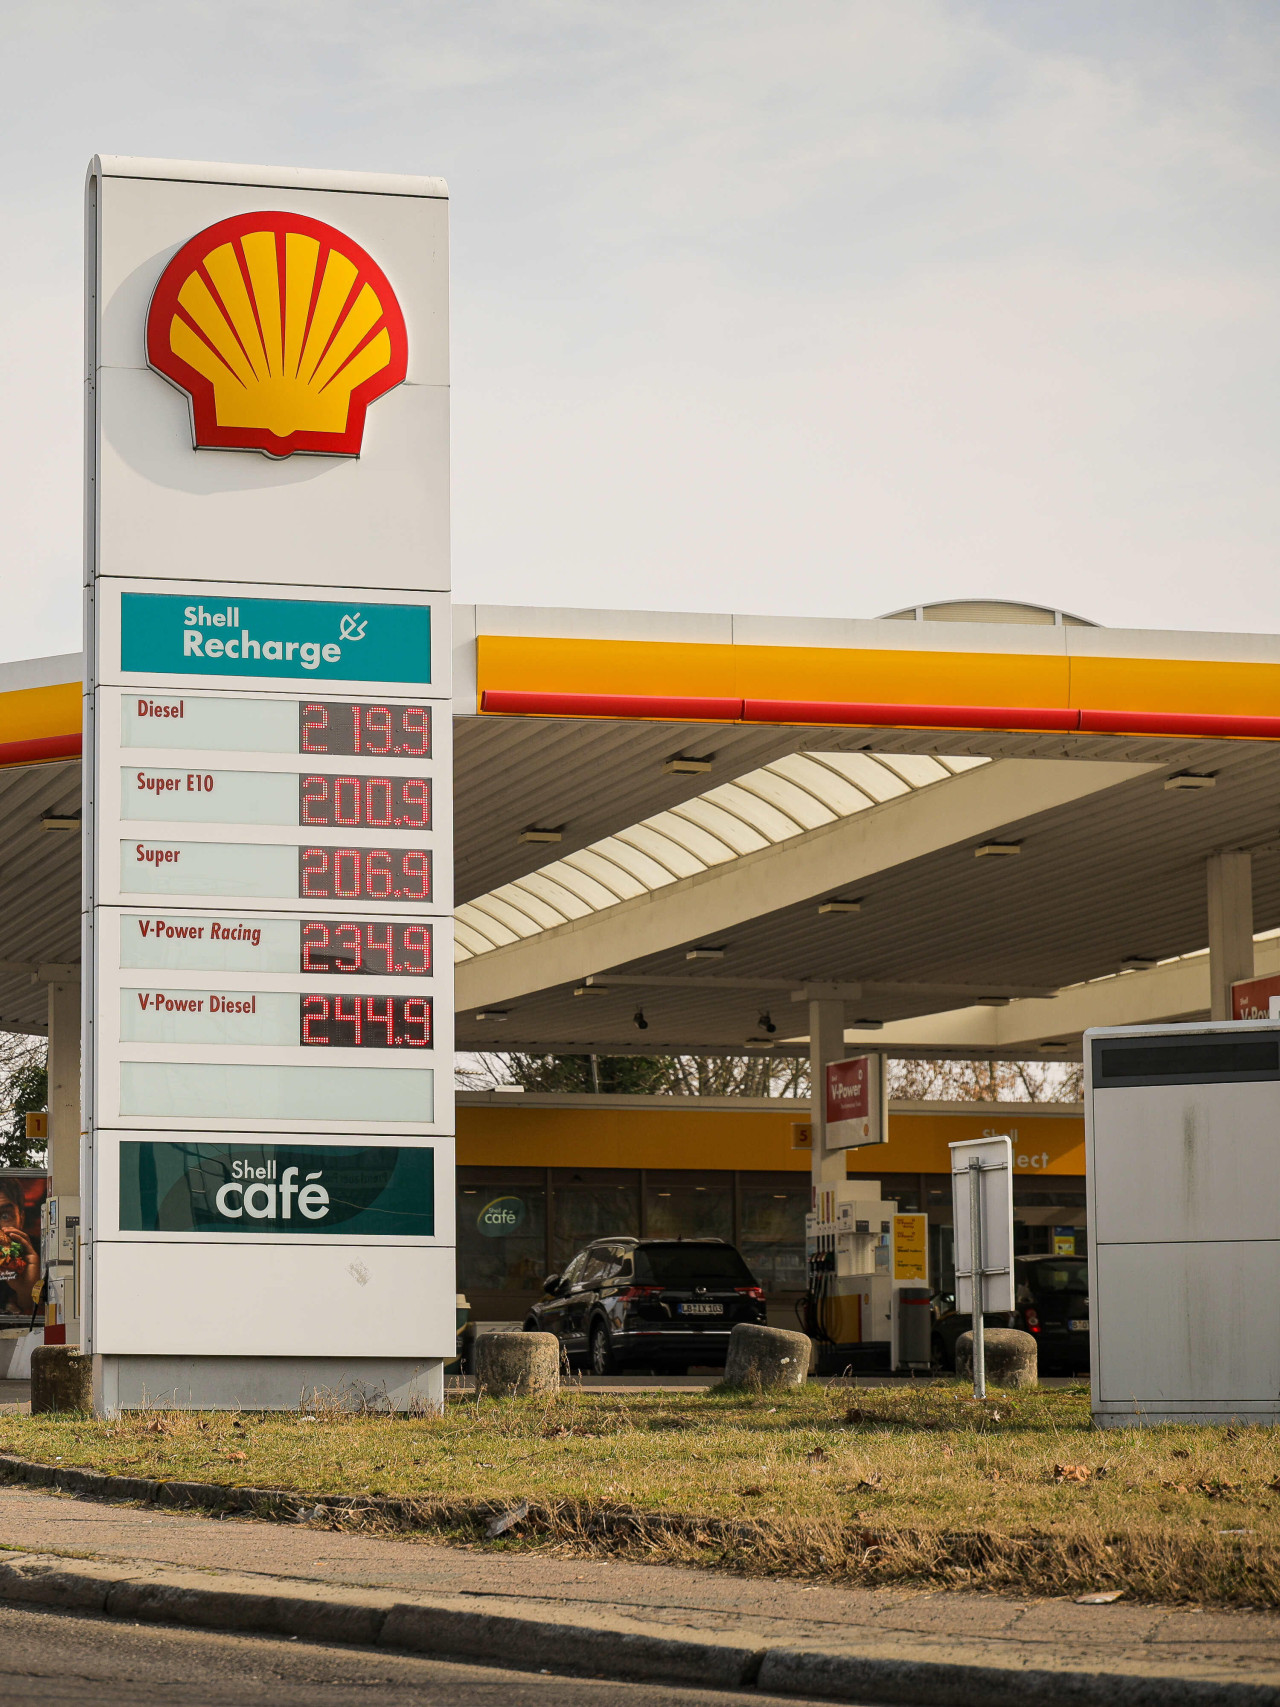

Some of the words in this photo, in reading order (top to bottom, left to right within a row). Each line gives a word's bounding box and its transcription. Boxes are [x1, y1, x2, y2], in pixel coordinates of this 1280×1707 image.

[184, 606, 239, 627] Shell
[184, 630, 342, 670] Recharge
[138, 699, 184, 718] Diesel
[302, 704, 429, 755] 219.9
[137, 772, 181, 795] Super
[187, 774, 214, 792] E10
[302, 776, 429, 827] 200.9
[136, 844, 180, 867] Super
[302, 848, 429, 899] 206.9
[139, 919, 204, 939] V-Power
[210, 922, 261, 946] Racing
[302, 922, 430, 973] 234.9
[138, 993, 203, 1012] V-Power
[210, 995, 256, 1014] Diesel
[1240, 1006, 1269, 1020] V-Pow
[302, 995, 430, 1046] 244.9
[831, 1083, 862, 1100] V-Power
[35, 1119, 41, 1131] 1
[799, 1129, 809, 1142] 5
[982, 1128, 1018, 1143] Shll
[1012, 1149, 1050, 1168] lect
[232, 1160, 277, 1180] Shell
[215, 1166, 330, 1219] café
[484, 1209, 516, 1224] café
